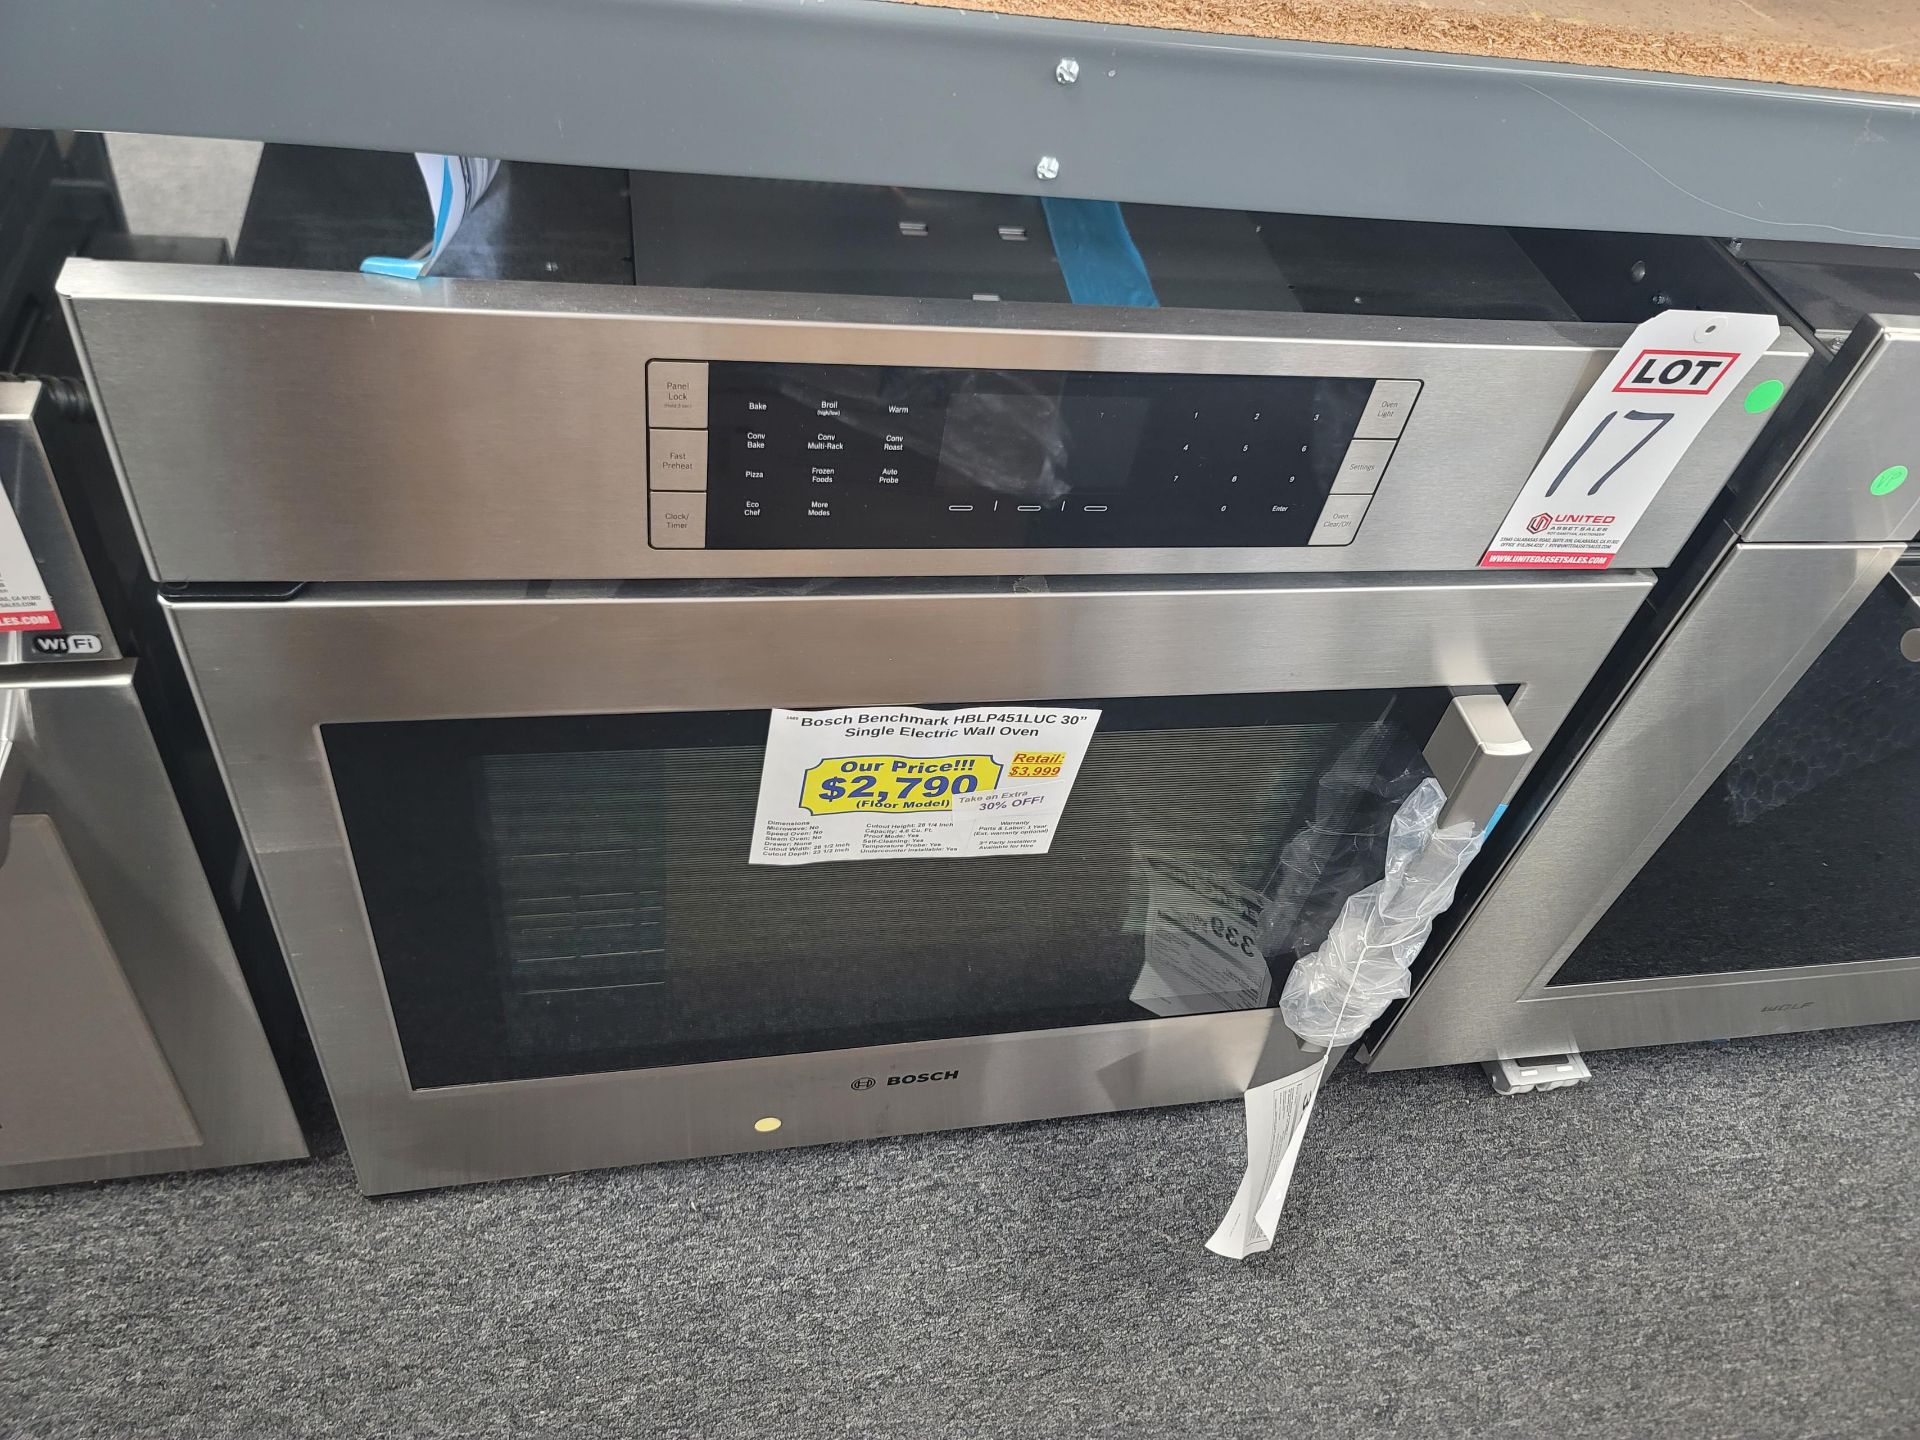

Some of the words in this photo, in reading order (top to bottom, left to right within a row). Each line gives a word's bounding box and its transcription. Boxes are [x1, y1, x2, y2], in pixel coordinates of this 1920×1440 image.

[1631, 359, 1723, 385] LOT
[667, 382, 689, 390] Panel
[749, 402, 767, 410] Bake
[1544, 409, 1675, 497] 17
[1554, 515, 1616, 523] UNITED
[1489, 555, 1608, 564] WWW.UNITEDASSETSALES.COM
[801, 715, 852, 726] Bosch
[858, 713, 948, 726] Benchmark
[954, 714, 1057, 724] HBLP451LUC
[845, 726, 894, 738] Single
[900, 727, 958, 738] Electric
[964, 726, 995, 736] Wall
[1000, 727, 1039, 736] Oven
[1013, 753, 1065, 764] Retail:
[840, 761, 884, 772] Our
[892, 760, 975, 773] Price!!!
[1008, 767, 1060, 777] $3,999
[819, 775, 978, 802] $2,790
[856, 800, 898, 809] (Floor
[903, 800, 950, 808] Model)
[979, 801, 1007, 810] 30%
[1012, 796, 1044, 807] OFF!
[887, 1070, 959, 1086] BOSCH
